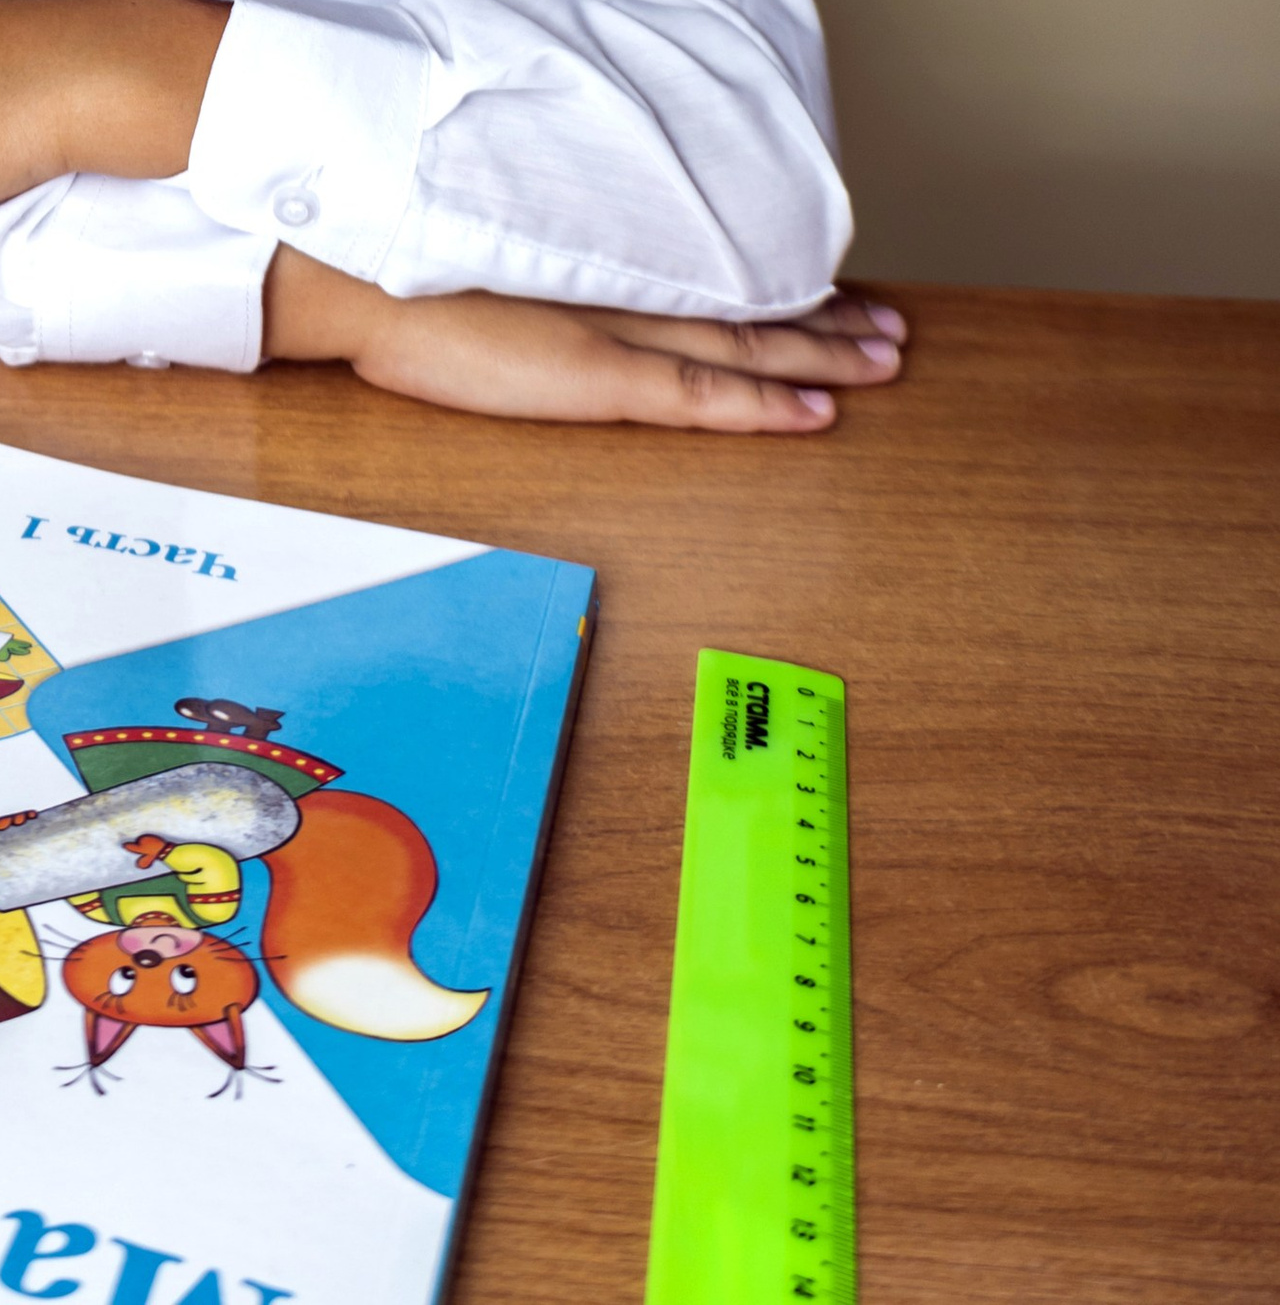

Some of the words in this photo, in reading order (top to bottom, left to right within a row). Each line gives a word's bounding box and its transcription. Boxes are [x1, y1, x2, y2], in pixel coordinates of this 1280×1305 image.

[20, 514, 50, 540] 1
[66, 525, 239, 581] Часть
[797, 687, 815, 697] 0
[797, 719, 815, 727] 1
[721, 708, 738, 761] порядке
[796, 749, 816, 760] 2
[796, 782, 816, 794] 3
[796, 818, 815, 829] 4
[796, 854, 816, 867] 5
[795, 893, 816, 905] 6
[795, 933, 817, 946] 7
[794, 974, 817, 988] 8
[793, 1019, 817, 1033] 9
[793, 1062, 817, 1085] 10
[792, 1113, 817, 1132] 11
